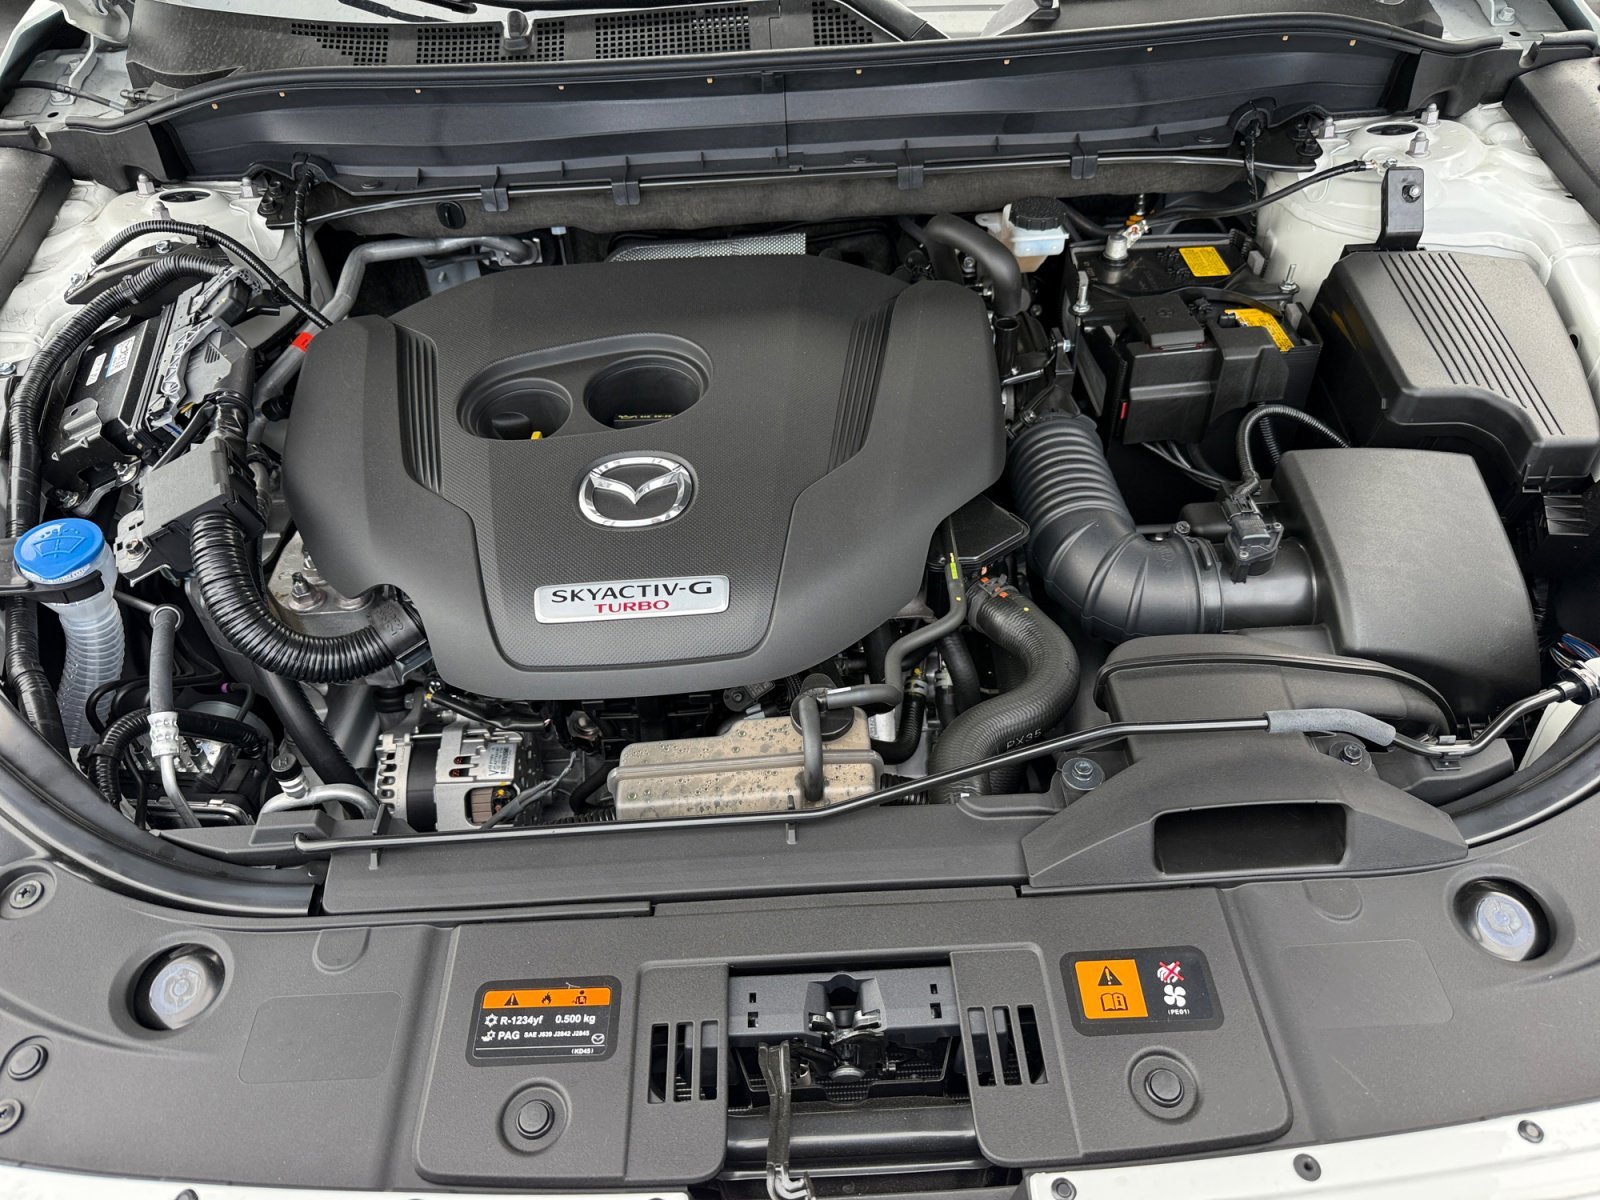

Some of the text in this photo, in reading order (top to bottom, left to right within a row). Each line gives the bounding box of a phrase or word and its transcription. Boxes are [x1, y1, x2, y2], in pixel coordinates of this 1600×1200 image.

[551, 581, 713, 604] SKYACTIV-G
[594, 600, 670, 614] TURBO
[500, 1015, 544, 1026] R-1234yf
[555, 1013, 596, 1024] 0.500 kg
[497, 1030, 521, 1040] PAG
